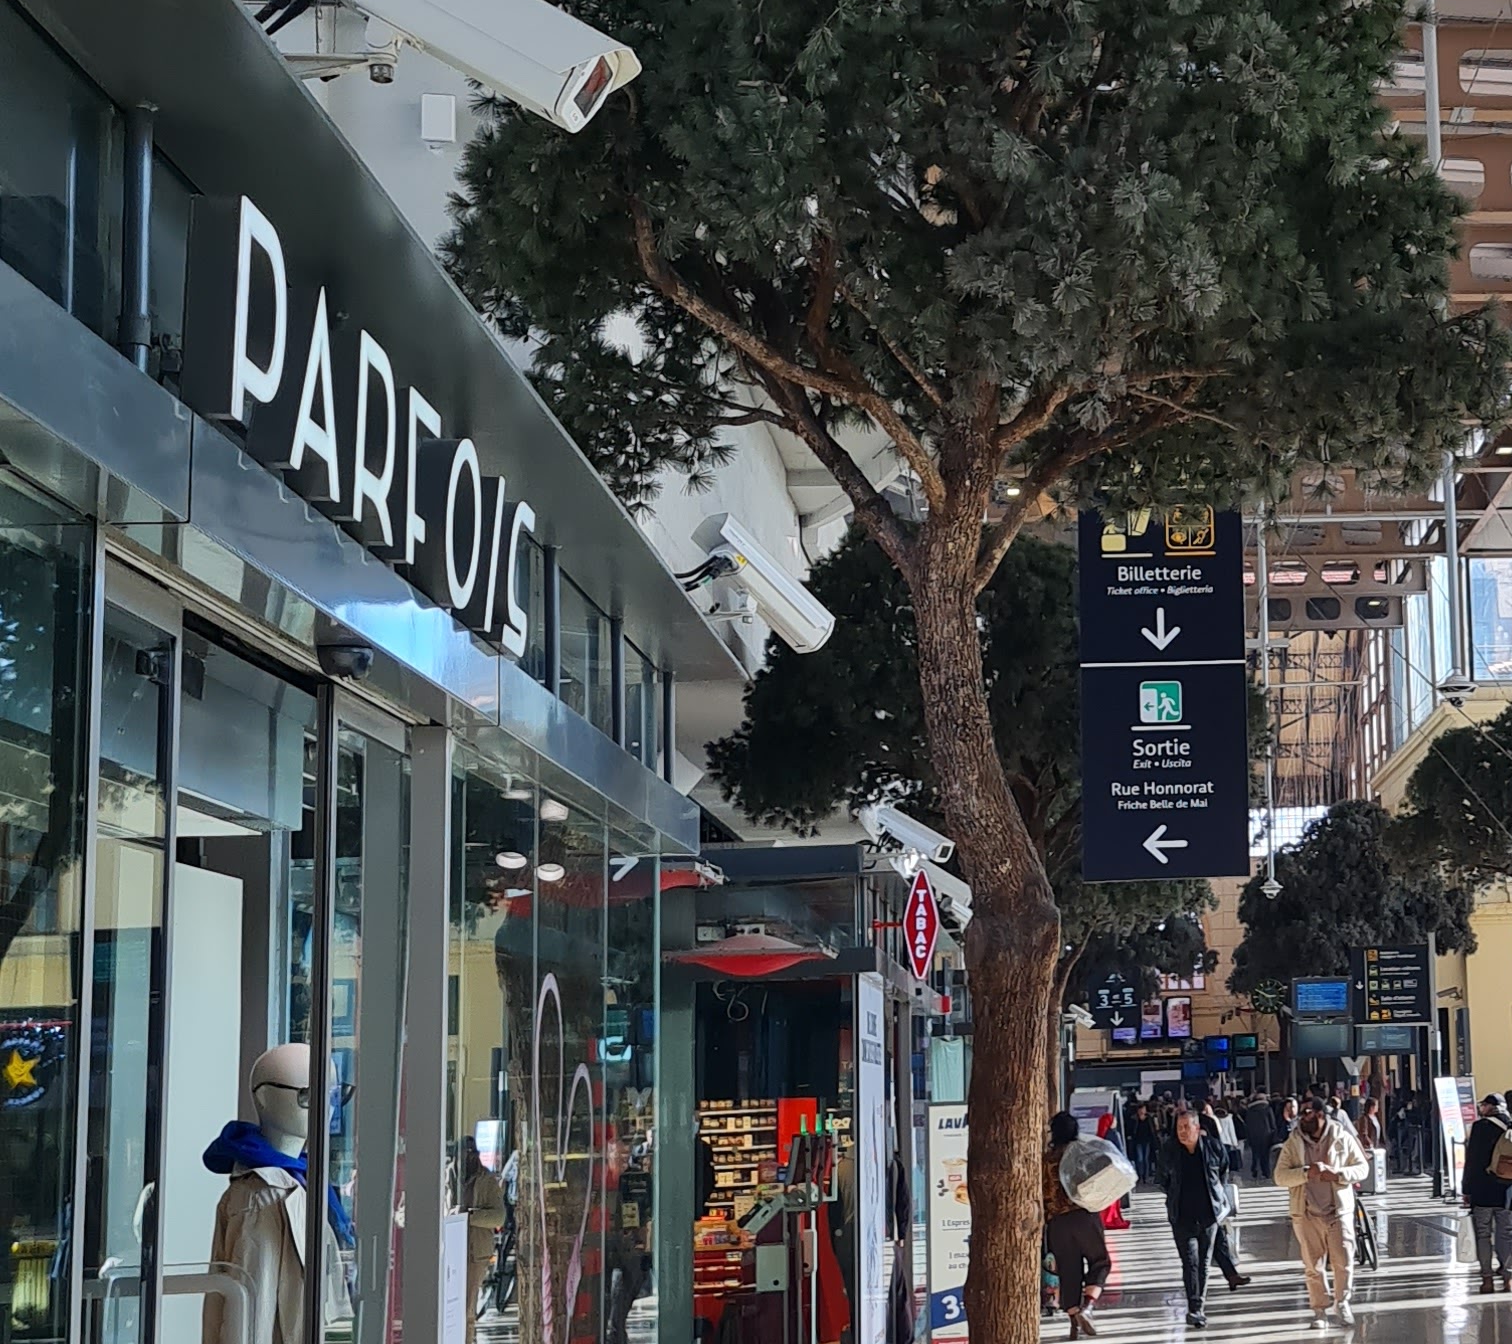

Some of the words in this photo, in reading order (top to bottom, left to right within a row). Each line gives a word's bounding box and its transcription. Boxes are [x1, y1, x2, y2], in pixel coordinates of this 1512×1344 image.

[231, 194, 536, 657] PARFOIS
[1117, 565, 1202, 581] Billetterie
[1107, 586, 1132, 595] Ticket
[1134, 586, 1159, 595] office
[1167, 584, 1213, 596] Biglietteria
[1132, 738, 1191, 756] Sortie
[1133, 759, 1152, 769] Exit
[1161, 758, 1192, 768] Uscita
[1111, 782, 1140, 796] Rue
[1144, 781, 1214, 795] Honnorat
[1118, 800, 1148, 810] Friche
[1149, 799, 1174, 809] Belle
[1176, 799, 1188, 808] de
[1190, 798, 1208, 808] Mai
[915, 889, 927, 958] TABAC
[1099, 994, 1109, 1007] 3
[1124, 993, 1134, 1005] 5
